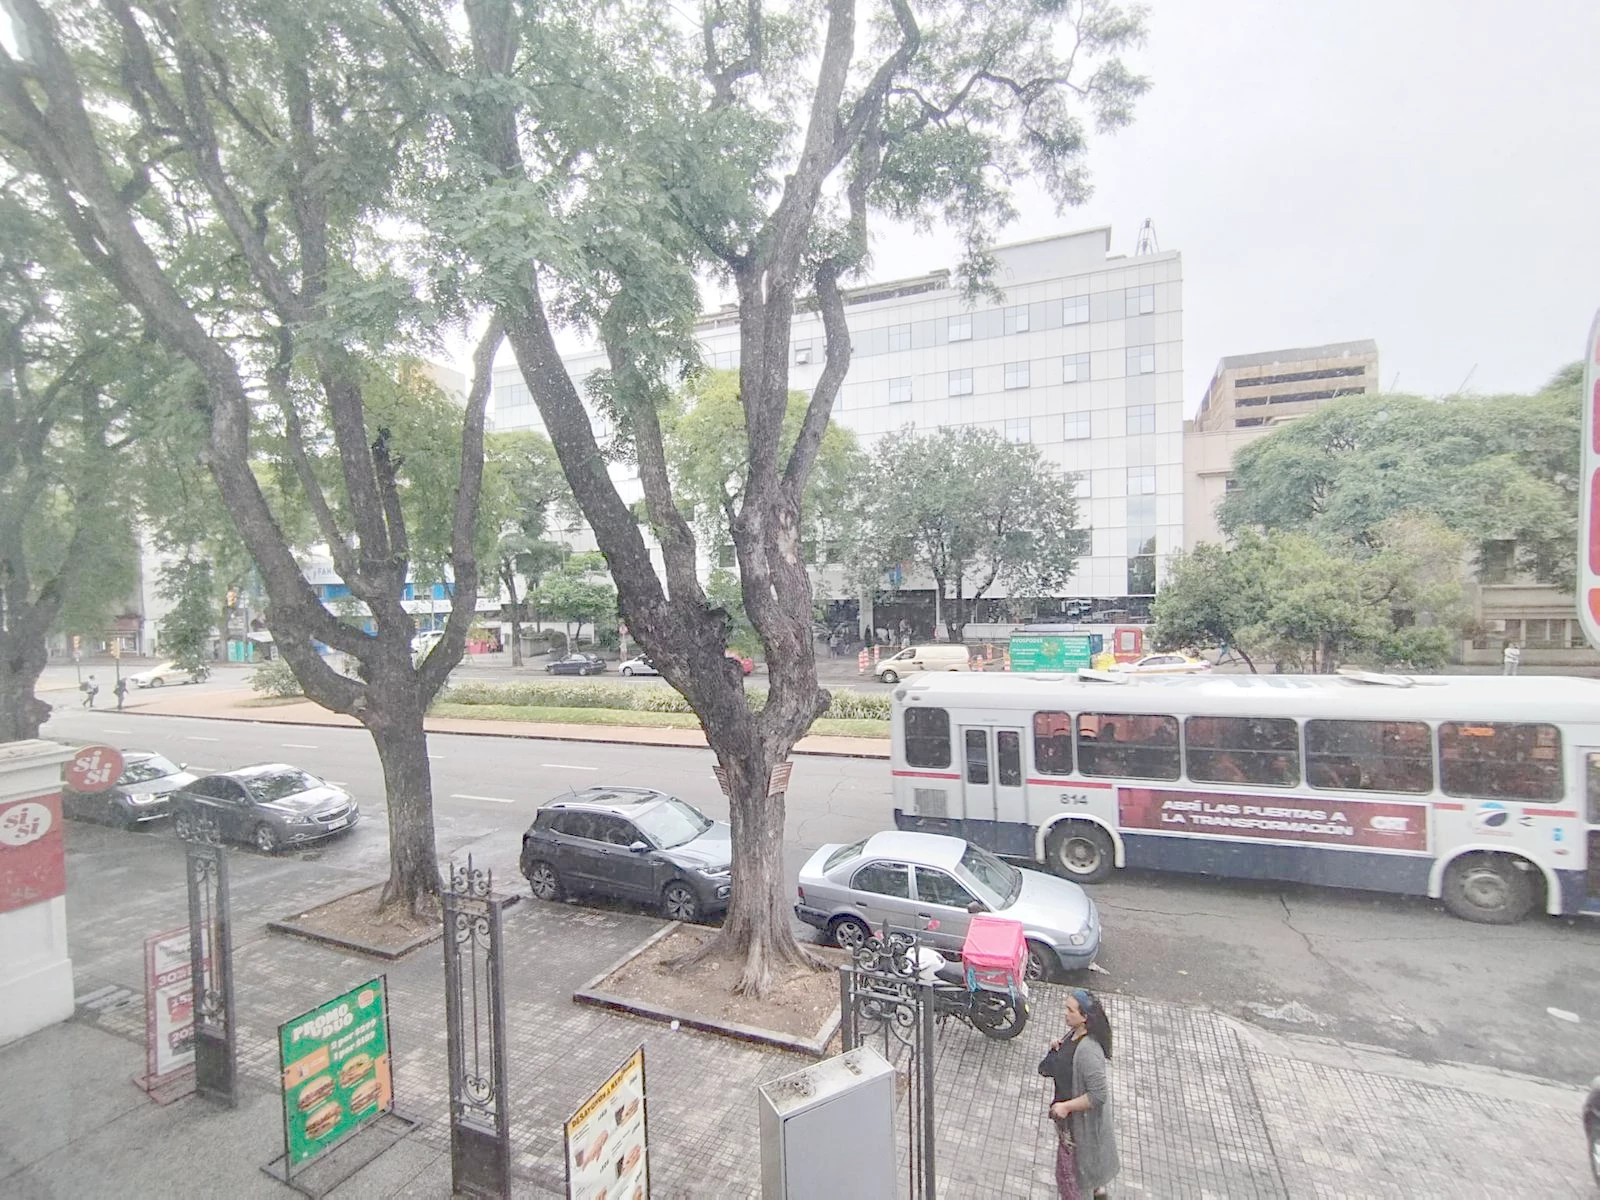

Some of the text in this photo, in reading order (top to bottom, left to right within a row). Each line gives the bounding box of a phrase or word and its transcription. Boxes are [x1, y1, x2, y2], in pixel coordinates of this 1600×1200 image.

[1059, 793, 1088, 805] 814
[1203, 803, 1240, 814] LAS
[1243, 805, 1327, 820] PUERTAS
[1330, 811, 1347, 822] A
[1161, 812, 1354, 836] LA TRANSFORMACIÓN
[292, 1003, 349, 1042] PROMO
